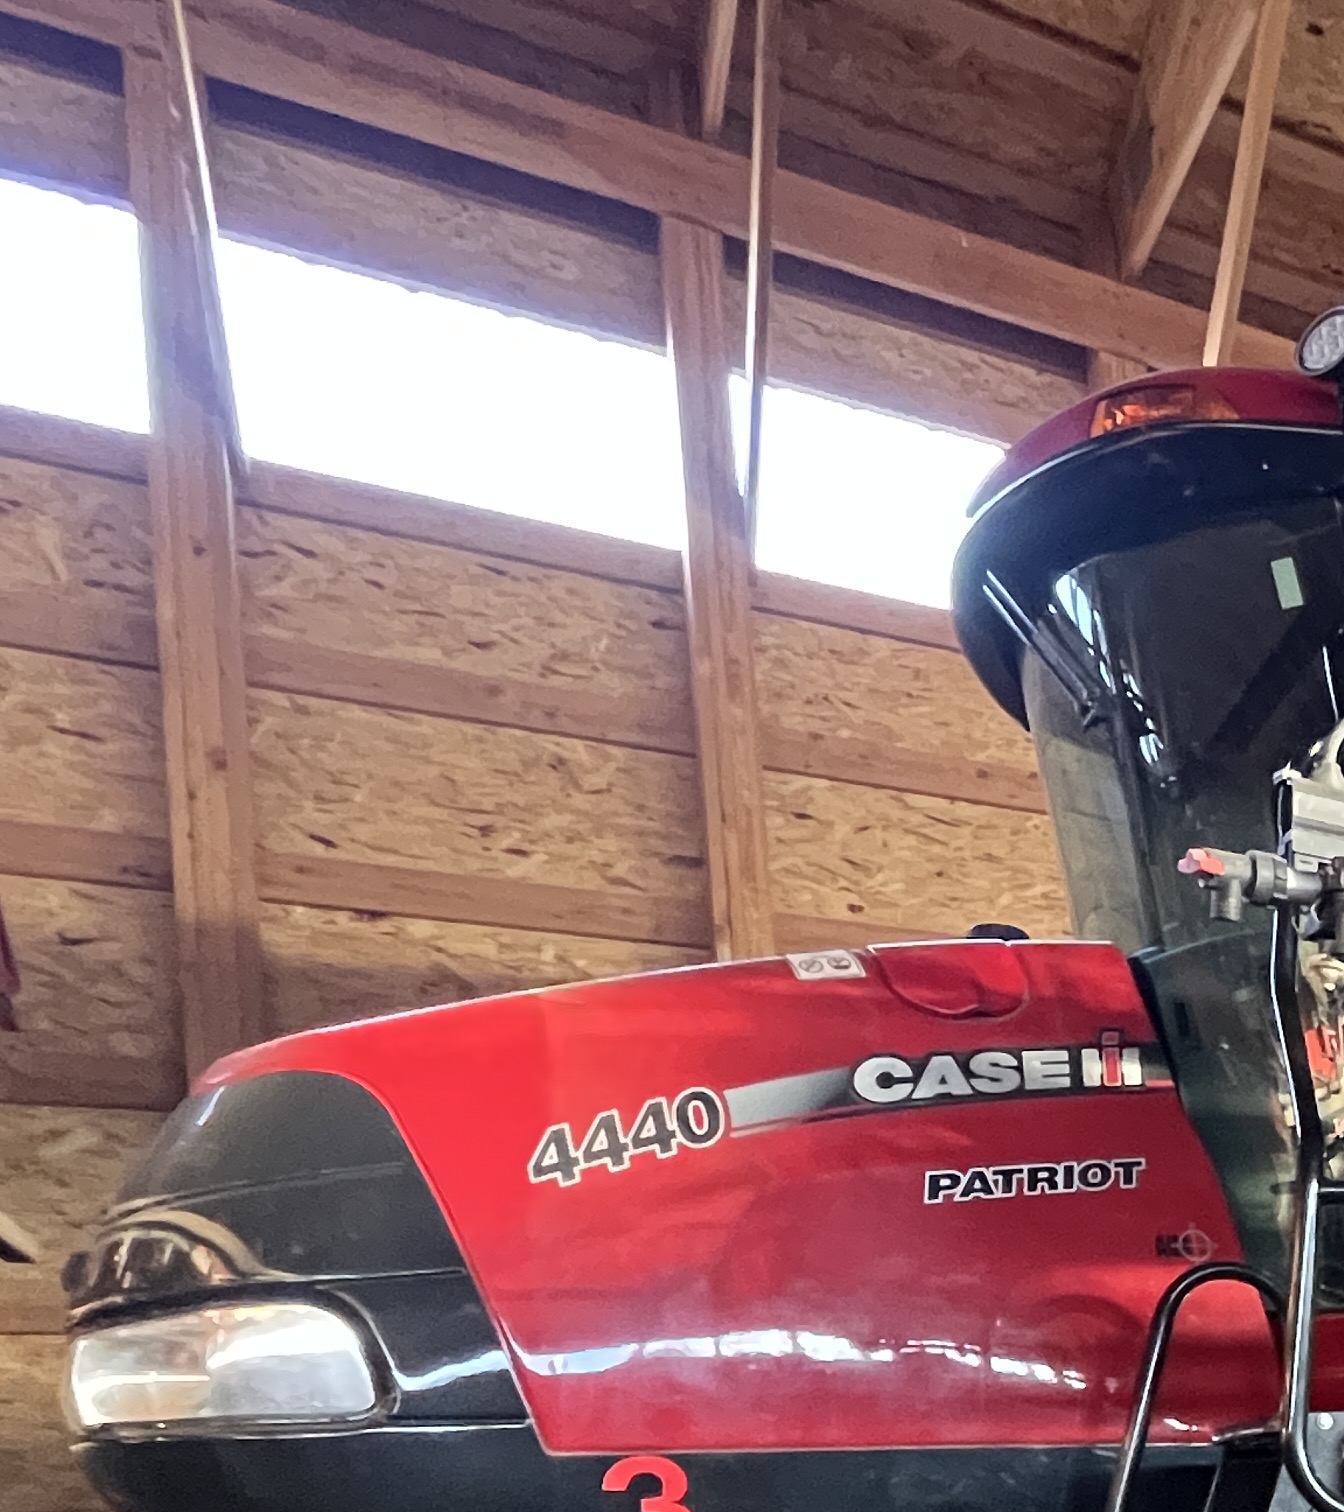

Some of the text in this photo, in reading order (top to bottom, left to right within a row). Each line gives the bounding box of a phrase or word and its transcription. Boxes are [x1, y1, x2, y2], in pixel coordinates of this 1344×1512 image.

[853, 1048, 1070, 1104] CASE
[528, 1086, 726, 1189] 4440
[924, 1158, 1146, 1205] PATRIOT
